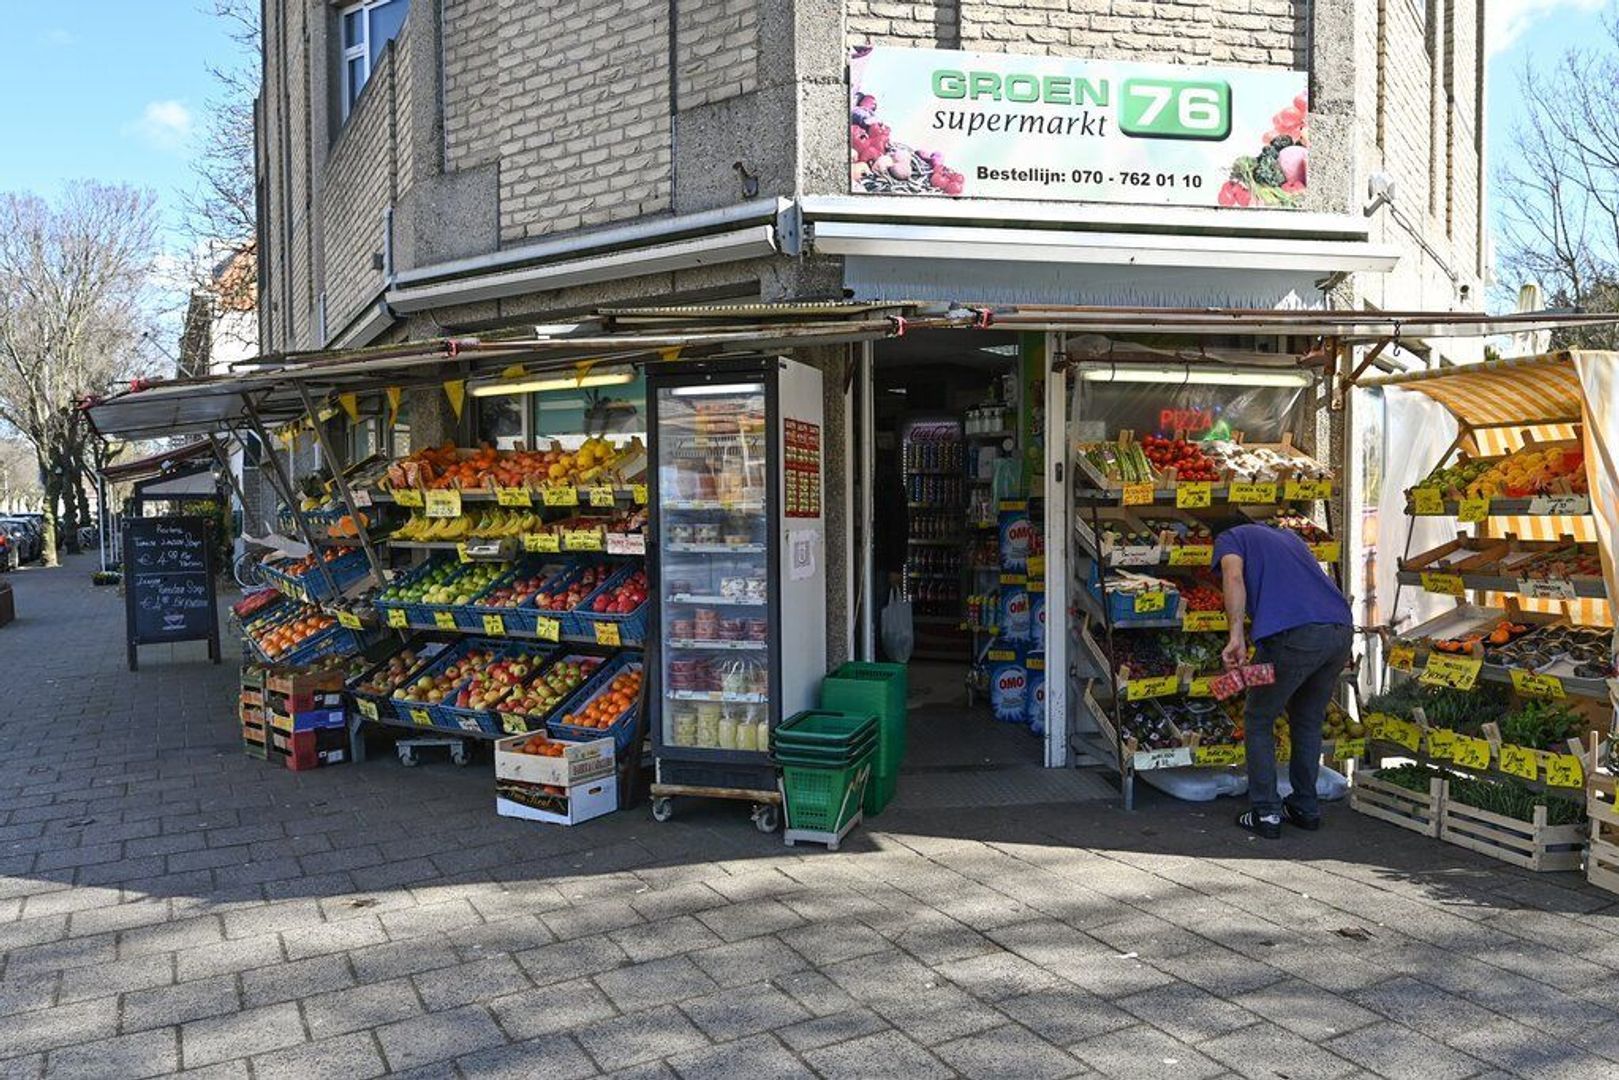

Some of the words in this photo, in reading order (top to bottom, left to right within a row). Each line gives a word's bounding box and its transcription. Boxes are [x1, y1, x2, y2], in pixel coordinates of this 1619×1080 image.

[931, 69, 1109, 107] GROEN
[1129, 84, 1221, 129] 76
[932, 110, 1107, 137] supermarkt
[977, 166, 1066, 185] Bestellijn:
[1072, 169, 1103, 184] 070
[1119, 171, 1151, 186] 762
[1156, 173, 1175, 187] 01
[1182, 174, 1202, 188] 10
[1160, 409, 1212, 430] PIZZA
[1000, 676, 1024, 689] OMO
